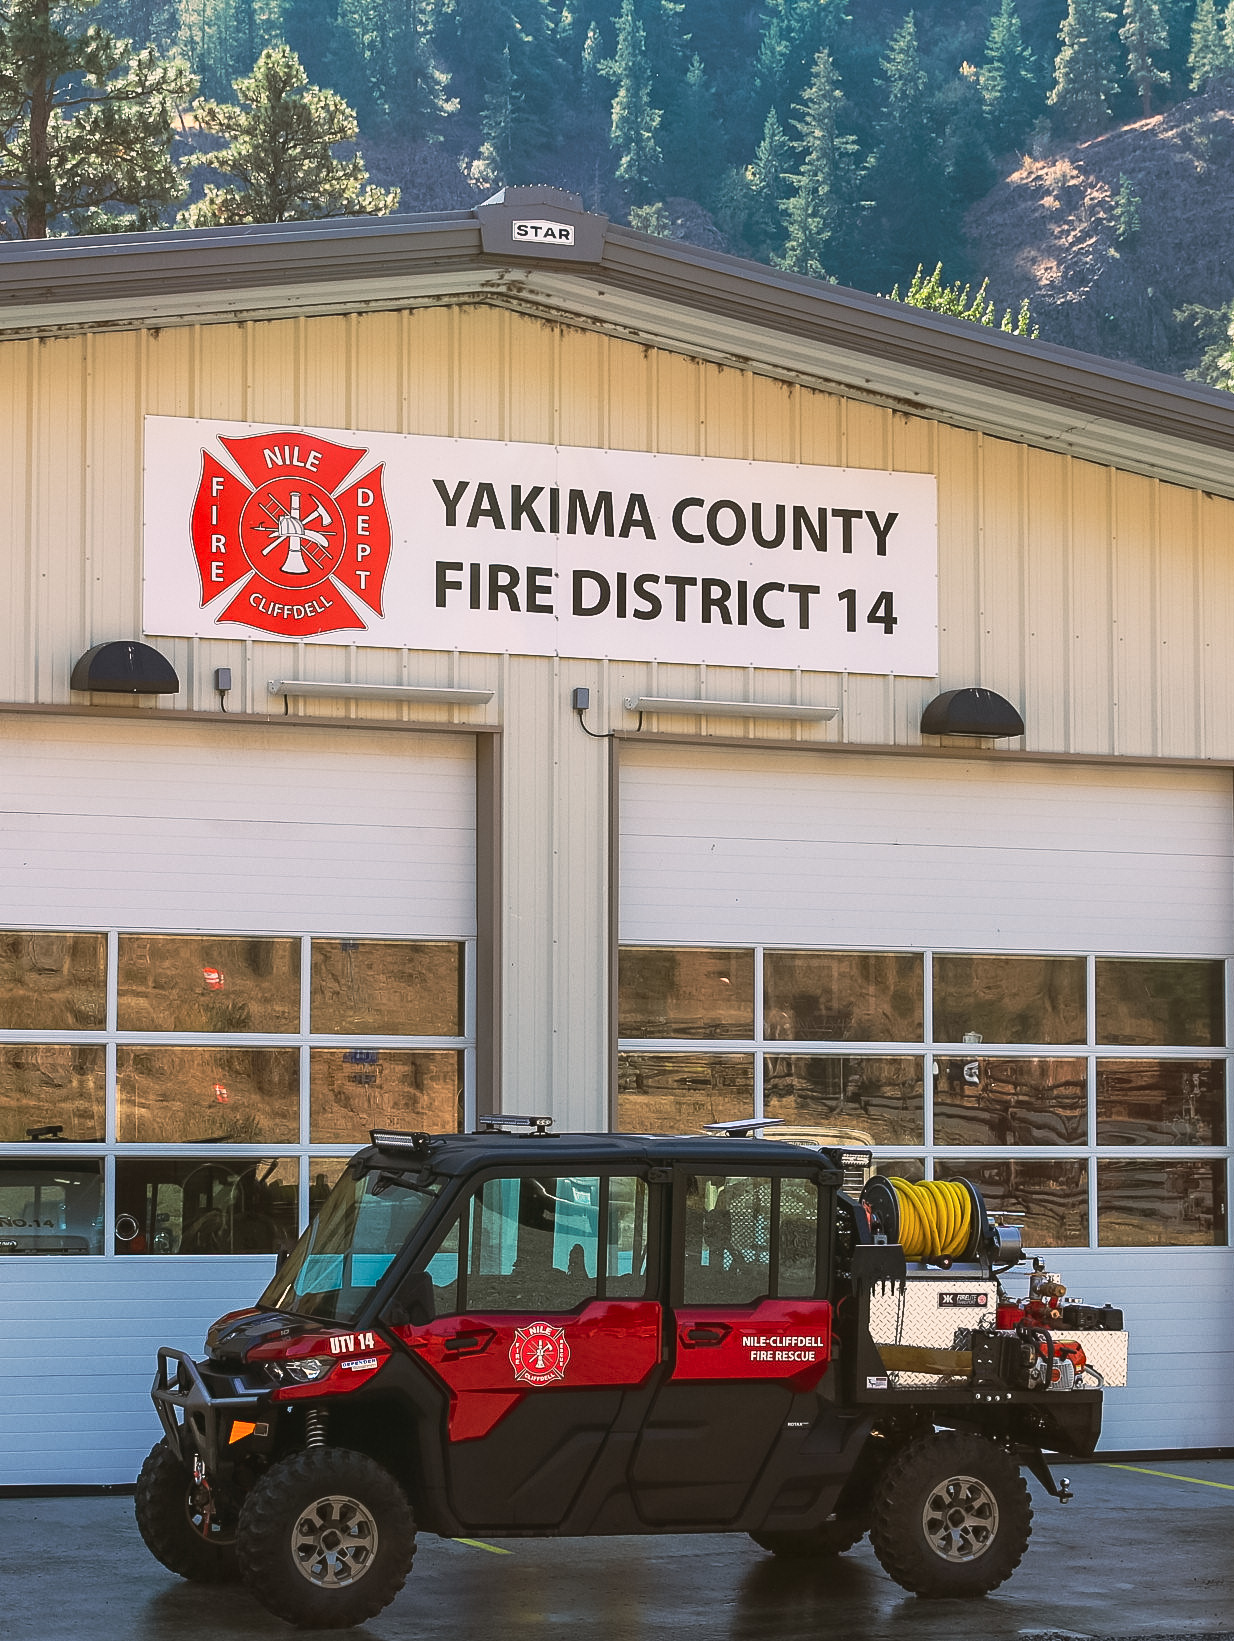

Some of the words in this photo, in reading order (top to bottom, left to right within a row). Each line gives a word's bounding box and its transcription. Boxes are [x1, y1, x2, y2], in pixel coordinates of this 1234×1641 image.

[516, 224, 571, 241] STAR
[262, 445, 323, 472] NILE
[210, 476, 227, 582] FIRE
[432, 478, 657, 540] YAKIMA
[672, 497, 899, 556] COUNTY
[356, 488, 375, 590] DEPT
[249, 592, 334, 619] CLIFFDELL
[435, 561, 554, 614] FIRE
[572, 569, 821, 629] DISTRICT
[837, 588, 898, 634] 14
[330, 1335, 355, 1354] UTV
[358, 1332, 375, 1350] 14
[529, 1326, 552, 1335] NILE
[742, 1336, 824, 1347] NILE-CLIFFDELL
[750, 1351, 774, 1361] FIRE
[775, 1351, 816, 1361] RESCUE
